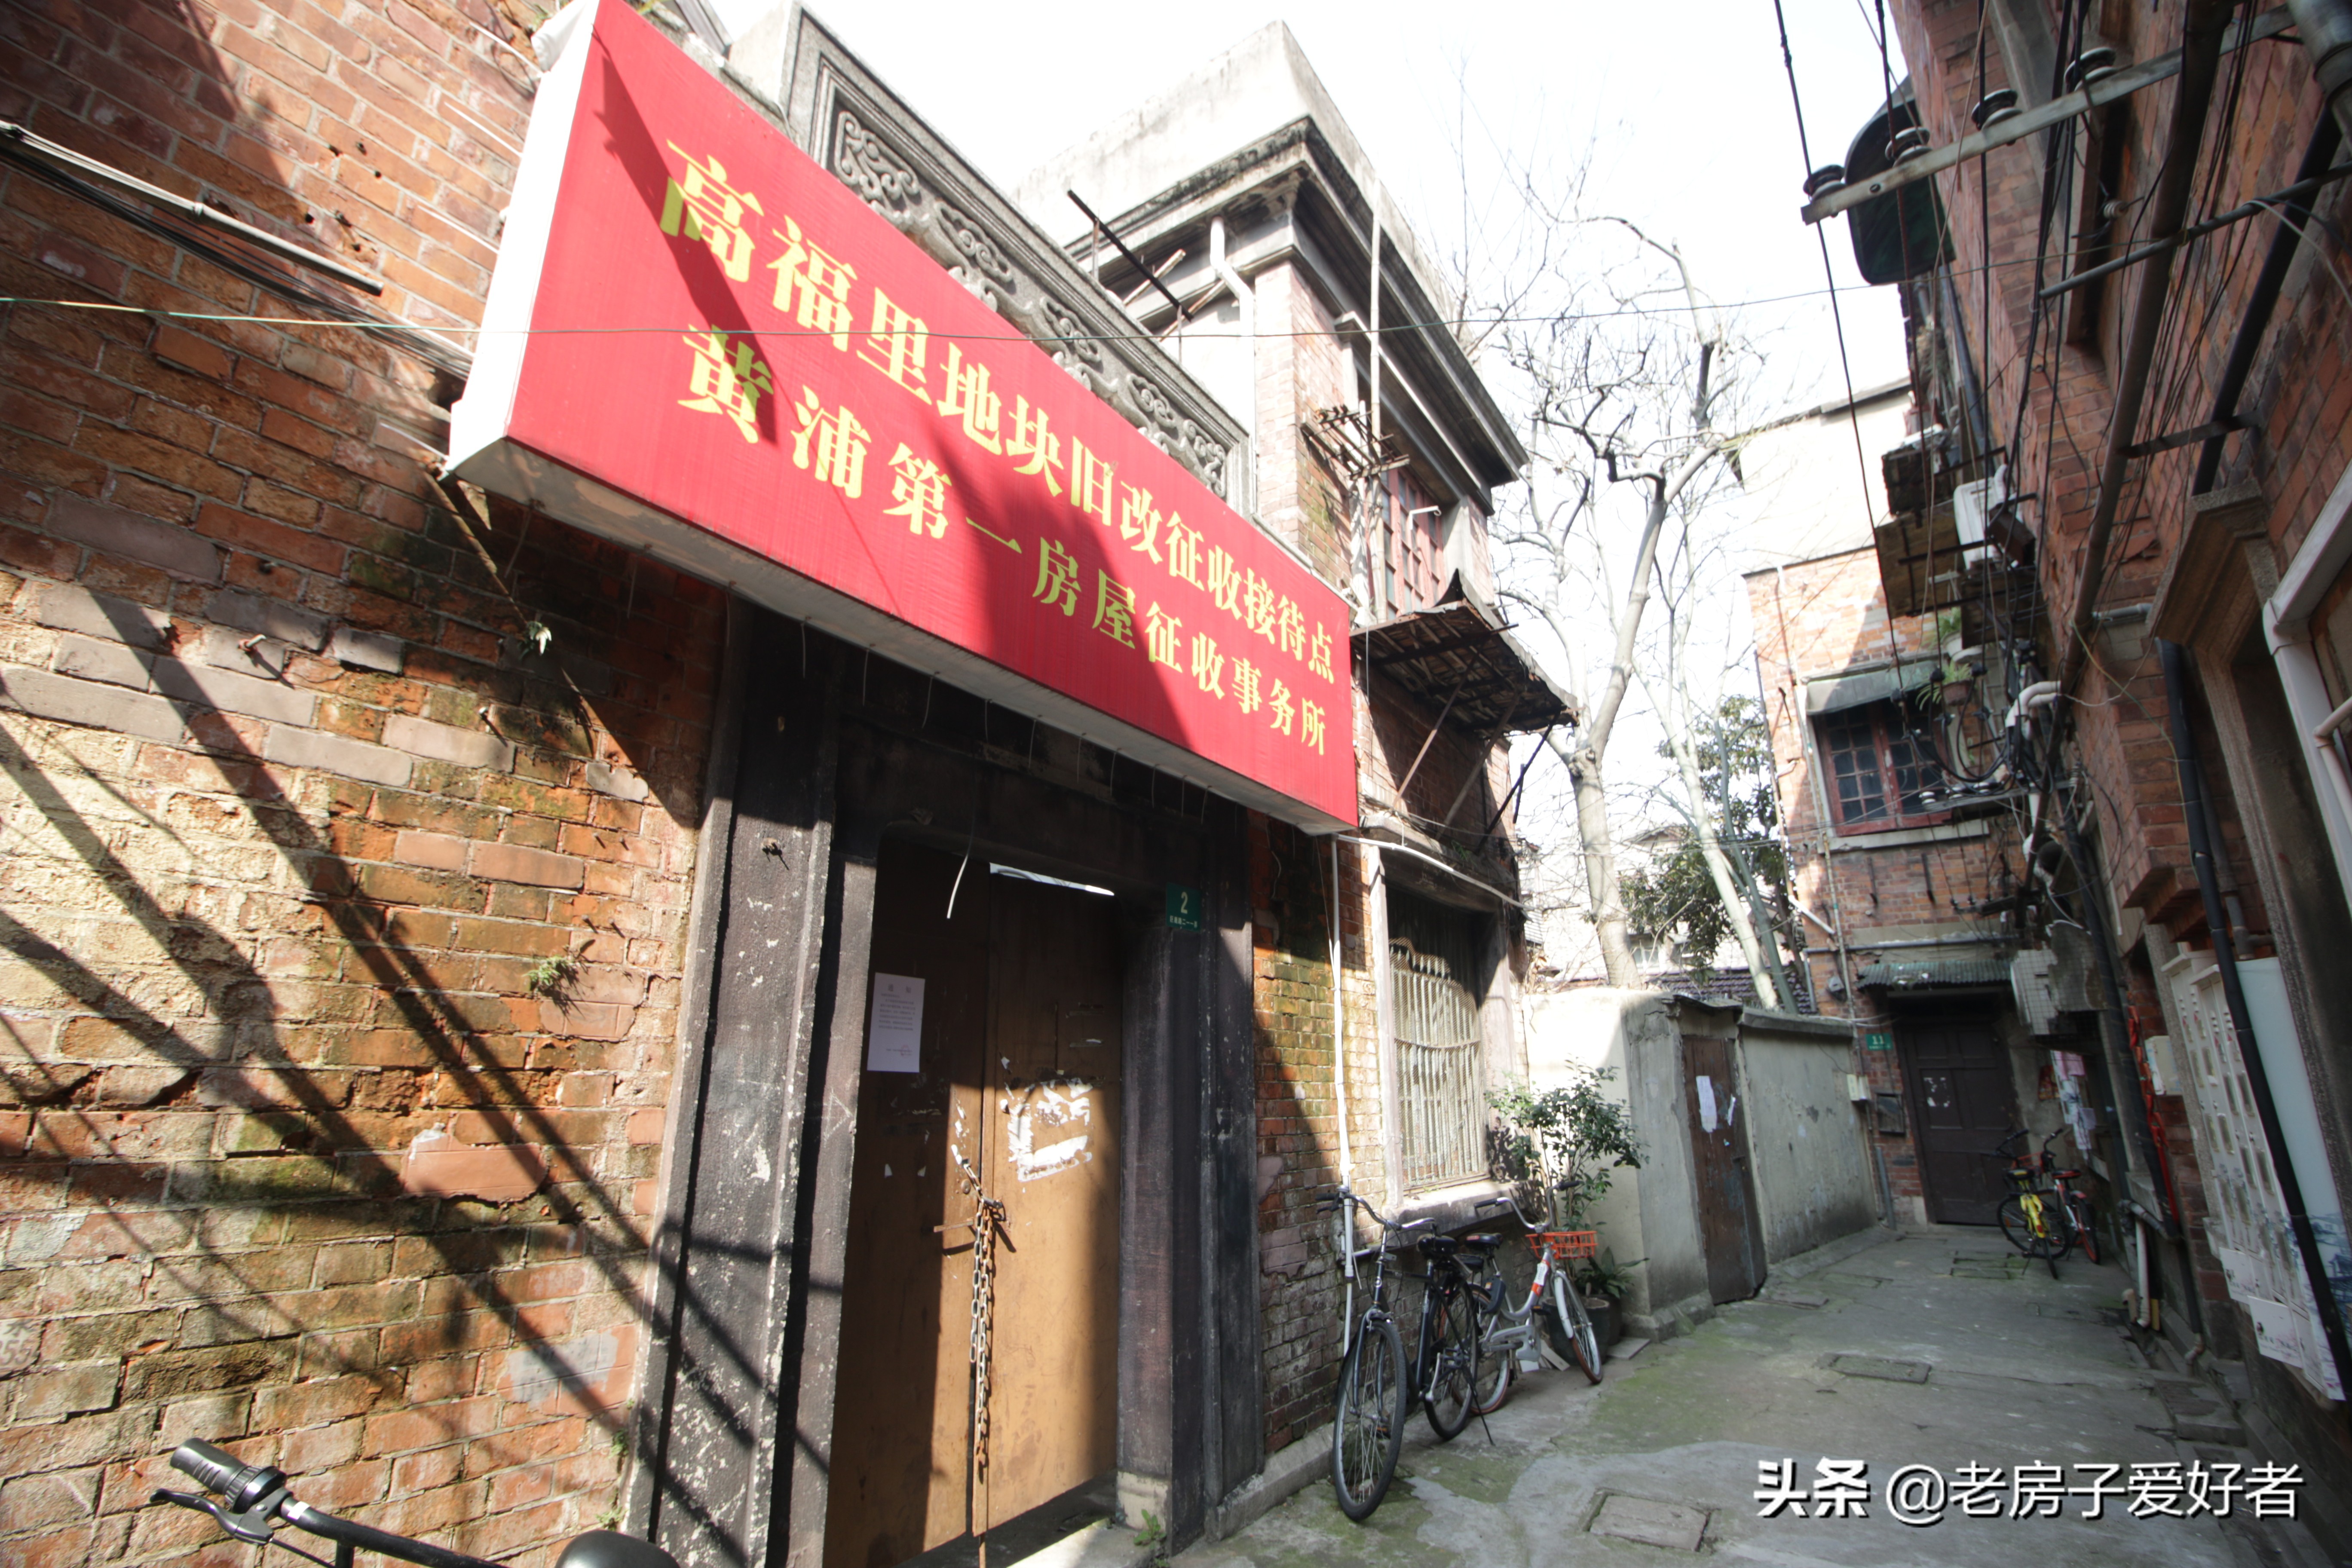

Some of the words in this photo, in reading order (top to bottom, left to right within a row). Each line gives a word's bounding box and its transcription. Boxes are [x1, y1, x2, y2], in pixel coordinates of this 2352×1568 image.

[660, 139, 1334, 684] 高福里地块旧改征收接待点
[677, 324, 1326, 755] 黄浦第一房屋征收事务所
[1180, 891, 1188, 914] 2
[1872, 1035, 1884, 1044] 11
